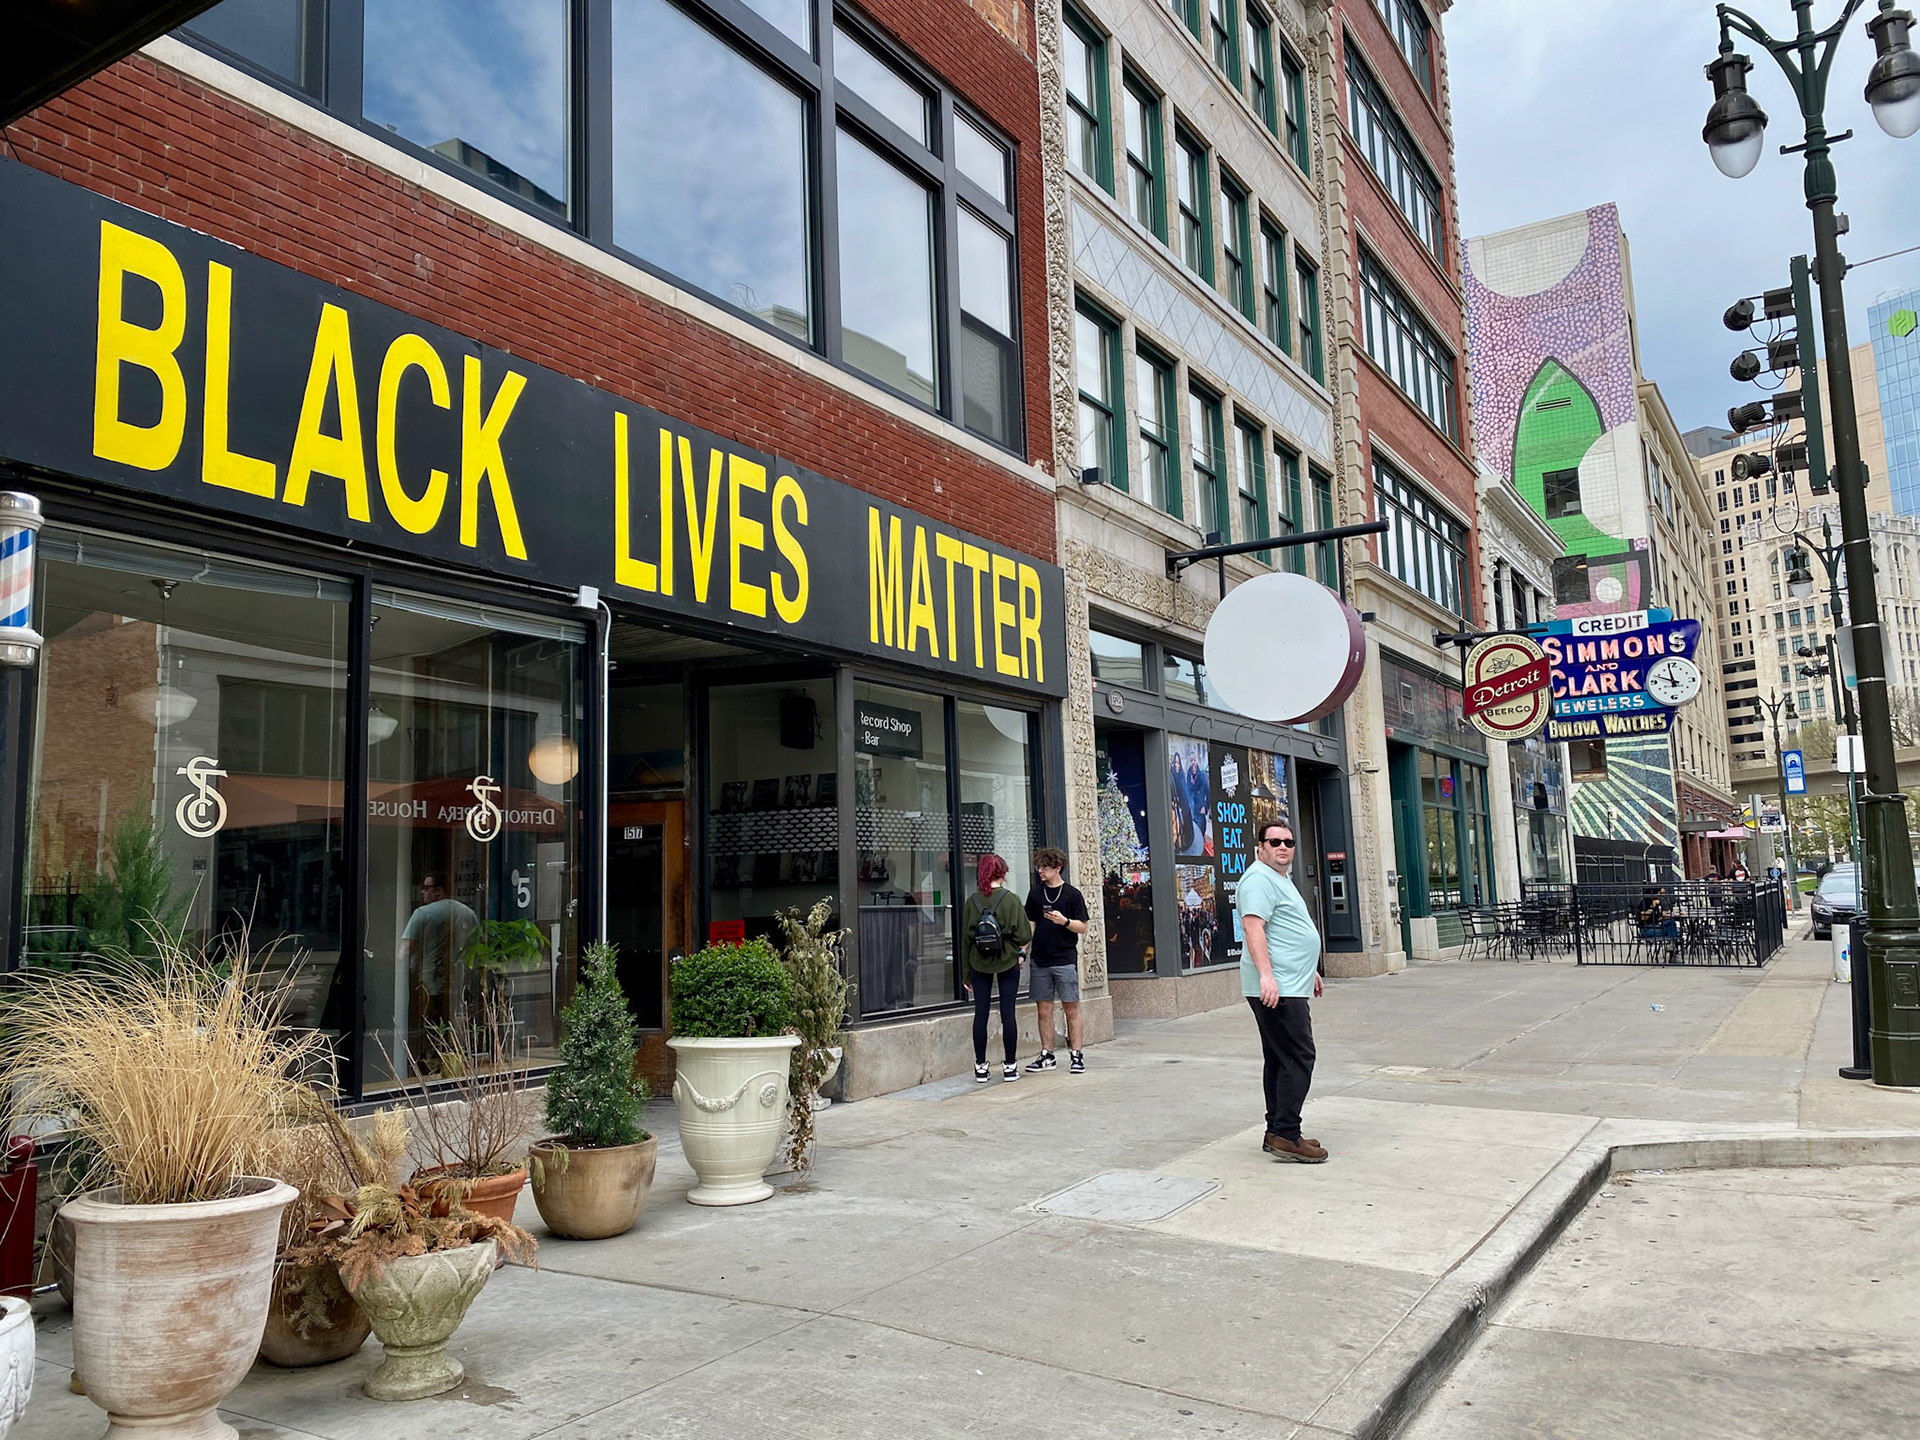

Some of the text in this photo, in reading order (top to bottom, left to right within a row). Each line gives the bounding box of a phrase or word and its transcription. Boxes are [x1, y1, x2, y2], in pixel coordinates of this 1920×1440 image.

[93, 220, 1044, 684] BLACK LIVES MATTER
[1578, 614, 1643, 633] CREDIT
[1505, 638, 1539, 656] BROADWAY
[1541, 631, 1687, 667] SIMMONS
[1585, 662, 1619, 673] AND
[1472, 669, 1541, 708] Detroit
[1550, 669, 1643, 699] CLARK
[889, 717, 912, 737] Shop
[1548, 712, 1668, 739] BULOVA WATCHES
[1217, 801, 1248, 824] SHOP.
[624, 827, 643, 840] 1517
[1222, 827, 1245, 849] EAT.
